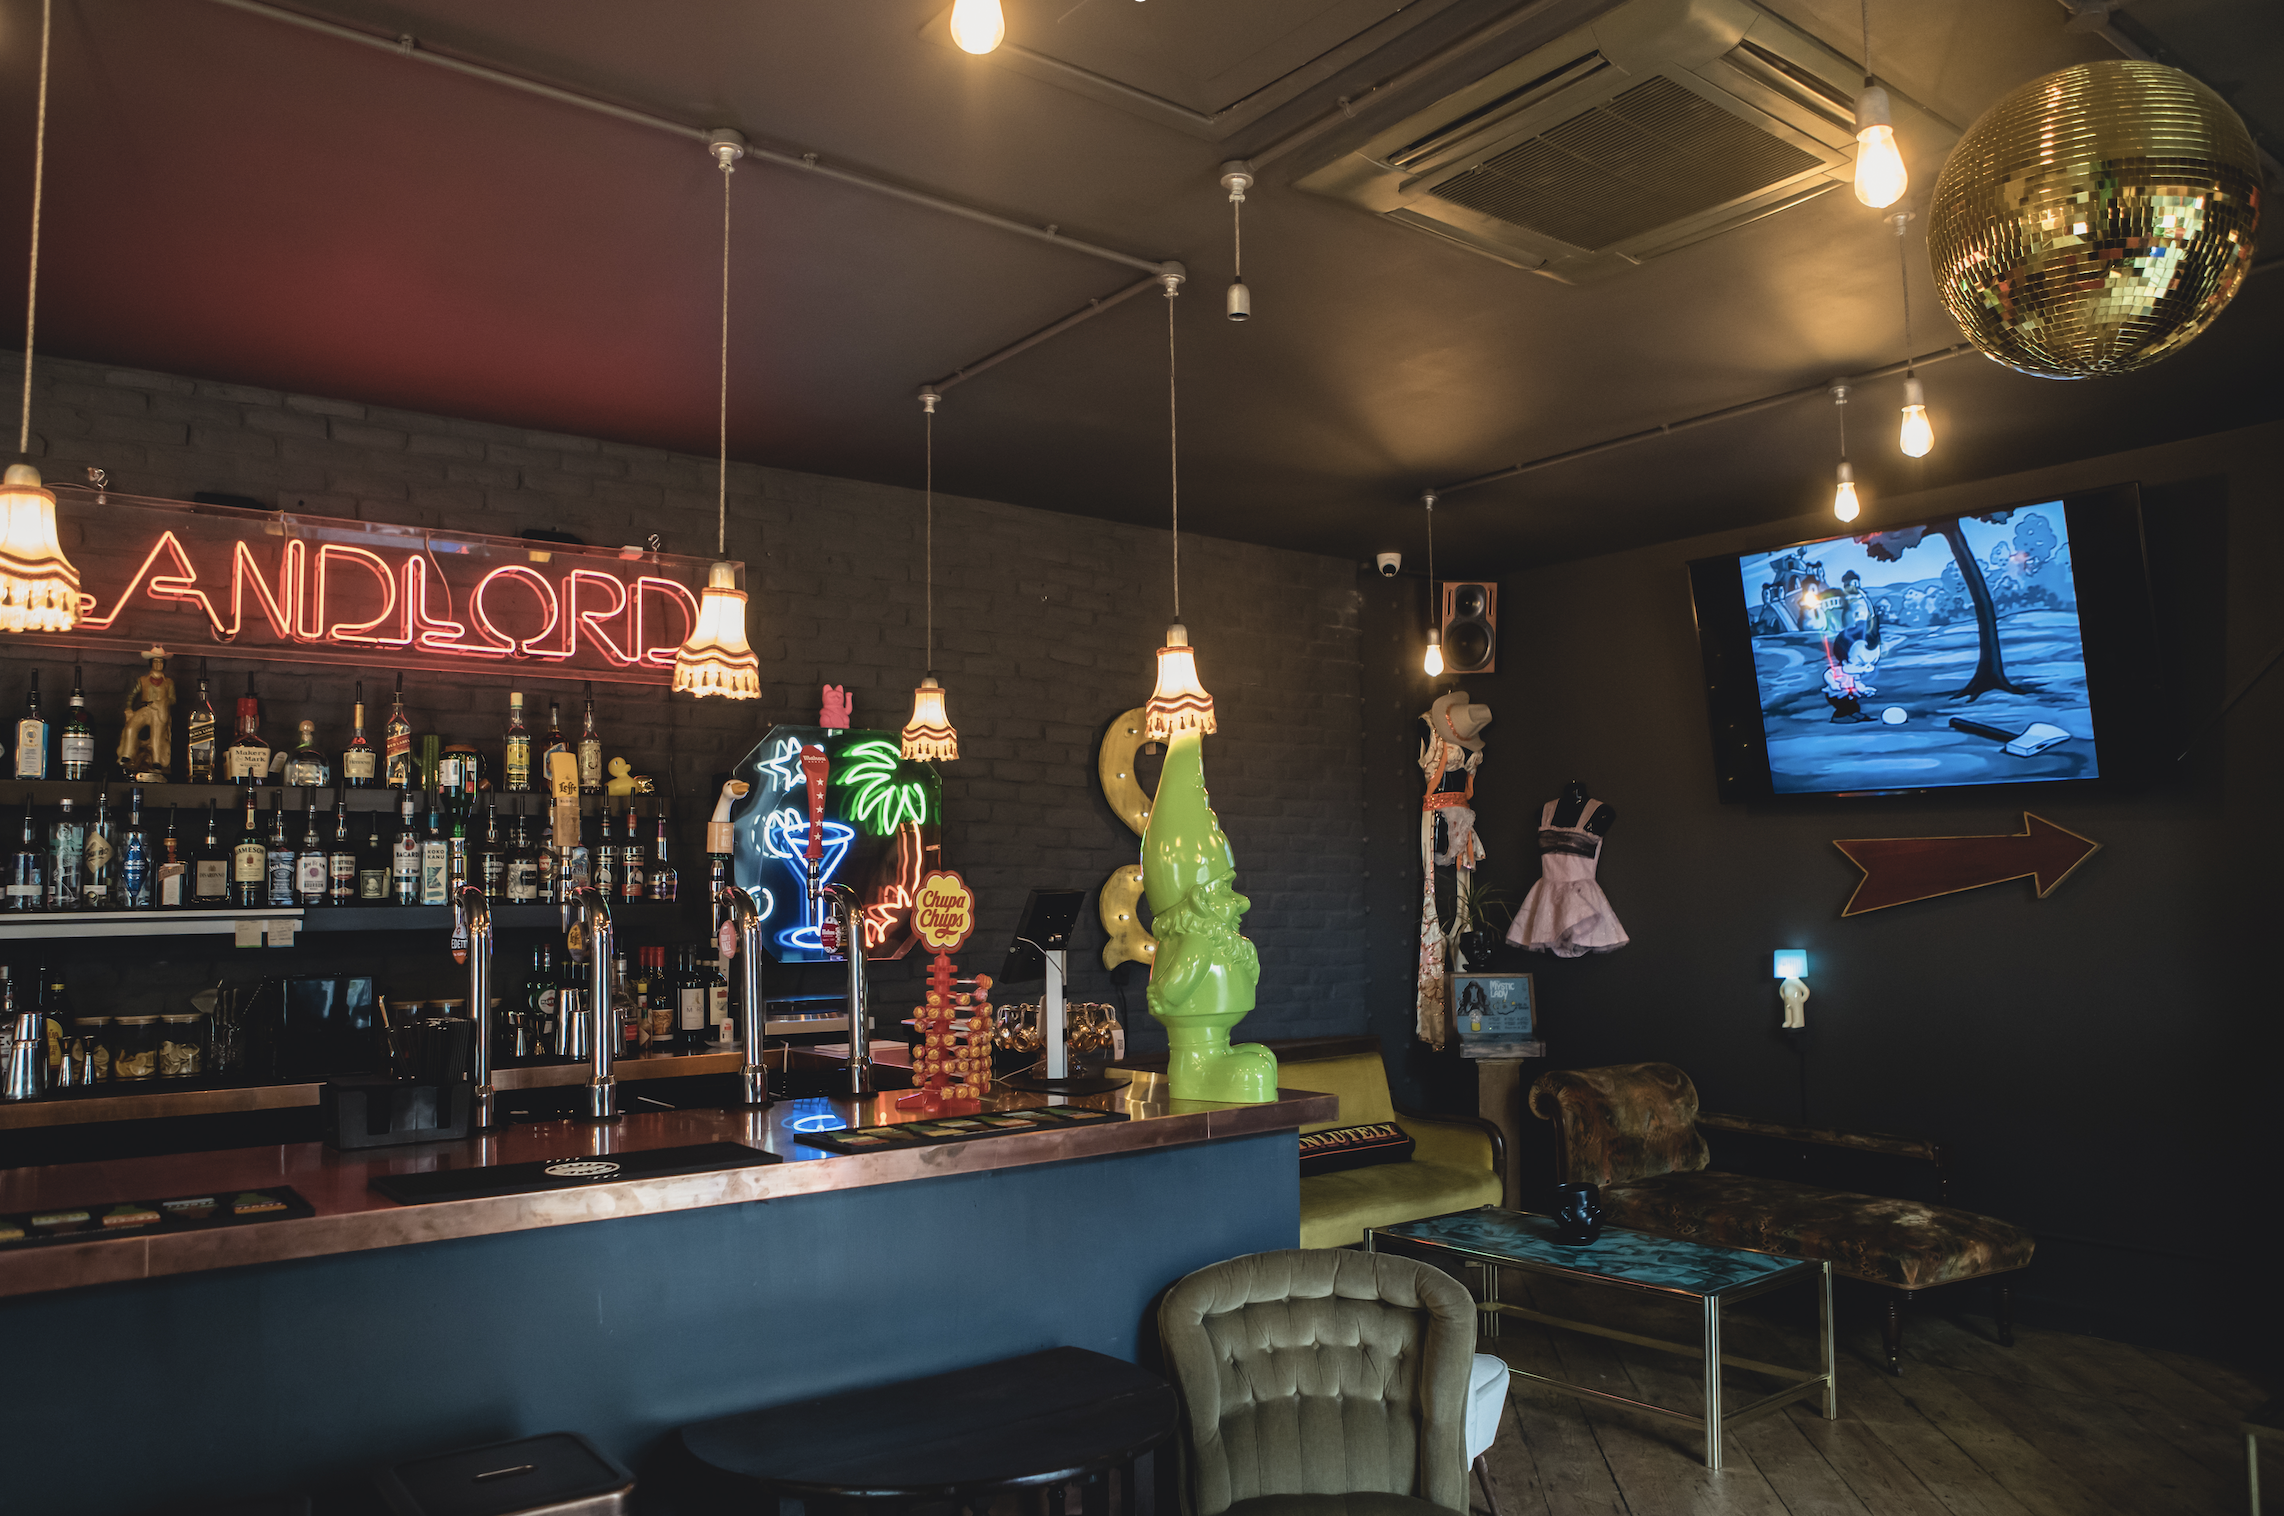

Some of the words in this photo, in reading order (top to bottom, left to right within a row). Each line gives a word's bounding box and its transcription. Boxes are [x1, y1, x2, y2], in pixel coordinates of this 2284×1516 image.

[80, 531, 701, 665] ANDLORD
[559, 781, 577, 795] Leffe
[235, 846, 264, 855] JAMESON
[922, 890, 966, 913] Chupa
[920, 908, 964, 939] Chups
[451, 939, 468, 949] EDETT
[1489, 980, 1515, 991] MYSTIC
[1490, 989, 1509, 1000] LADY
